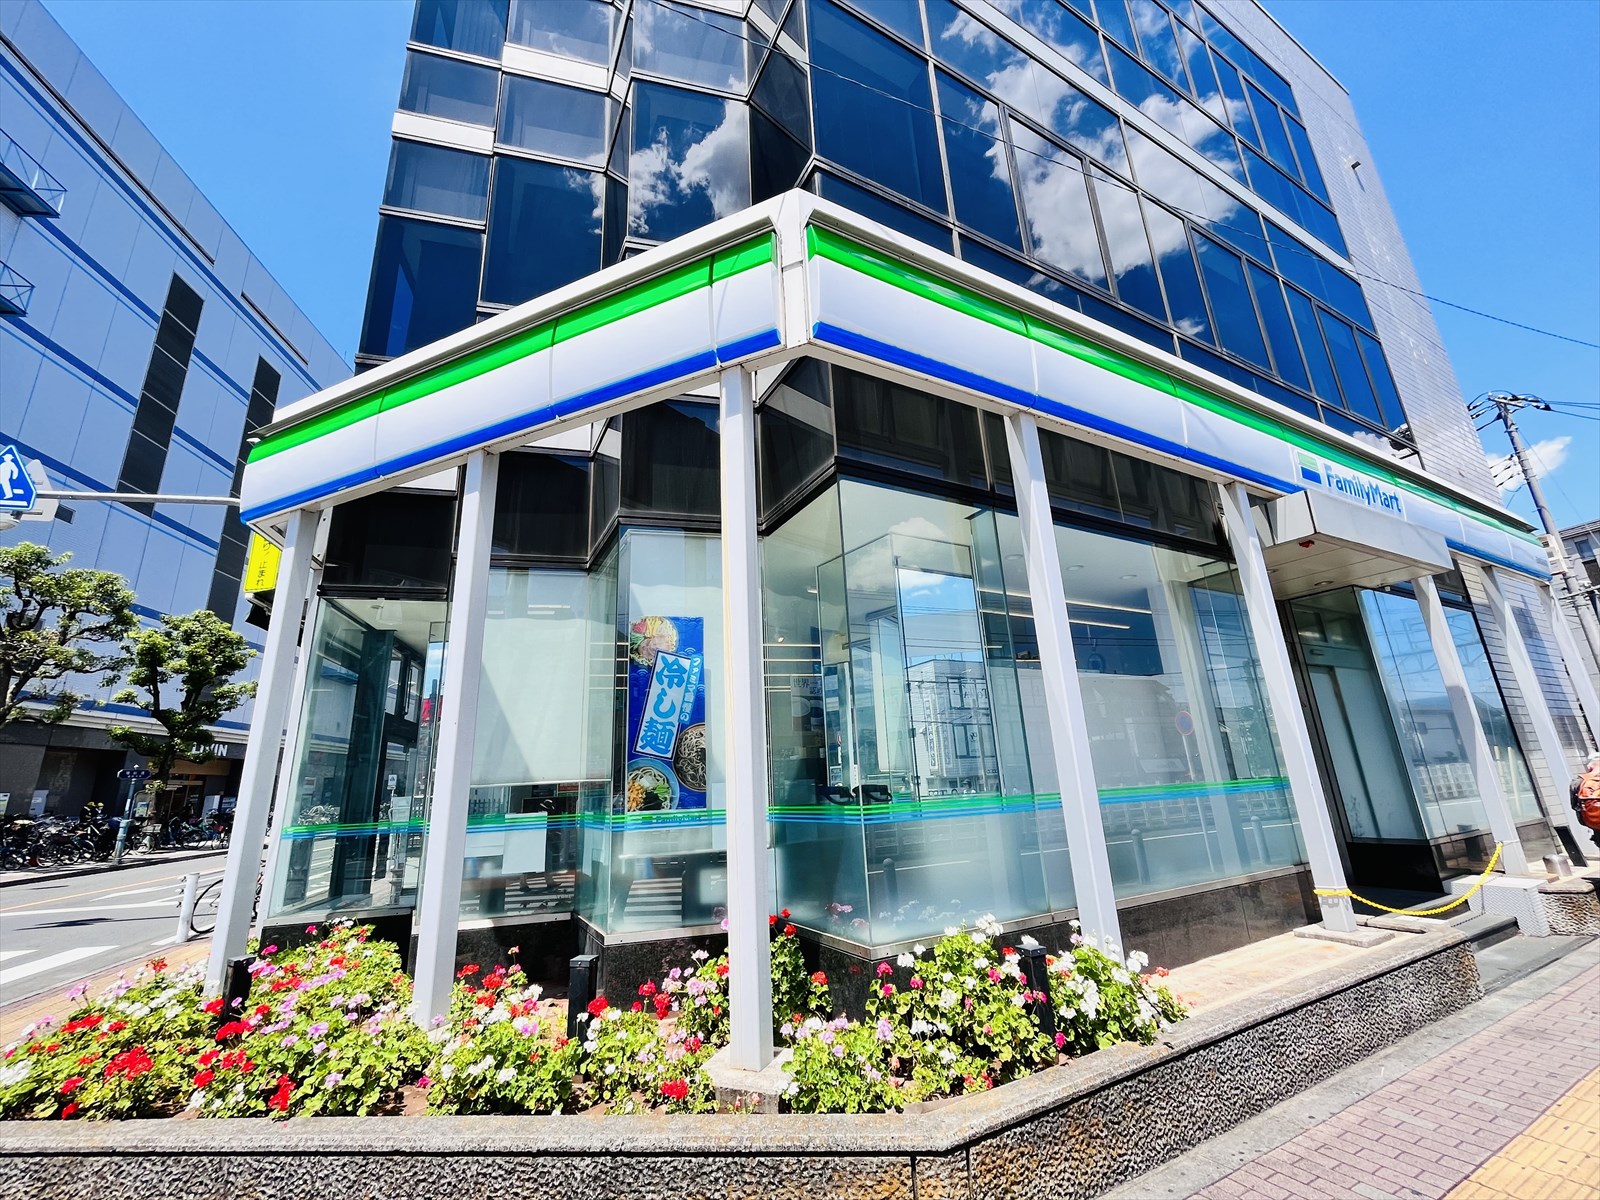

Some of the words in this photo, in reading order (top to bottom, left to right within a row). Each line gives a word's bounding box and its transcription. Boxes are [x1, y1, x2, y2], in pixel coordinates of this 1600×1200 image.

[1323, 462, 1402, 513] FamilyMart
[638, 653, 690, 756] 冷し麺
